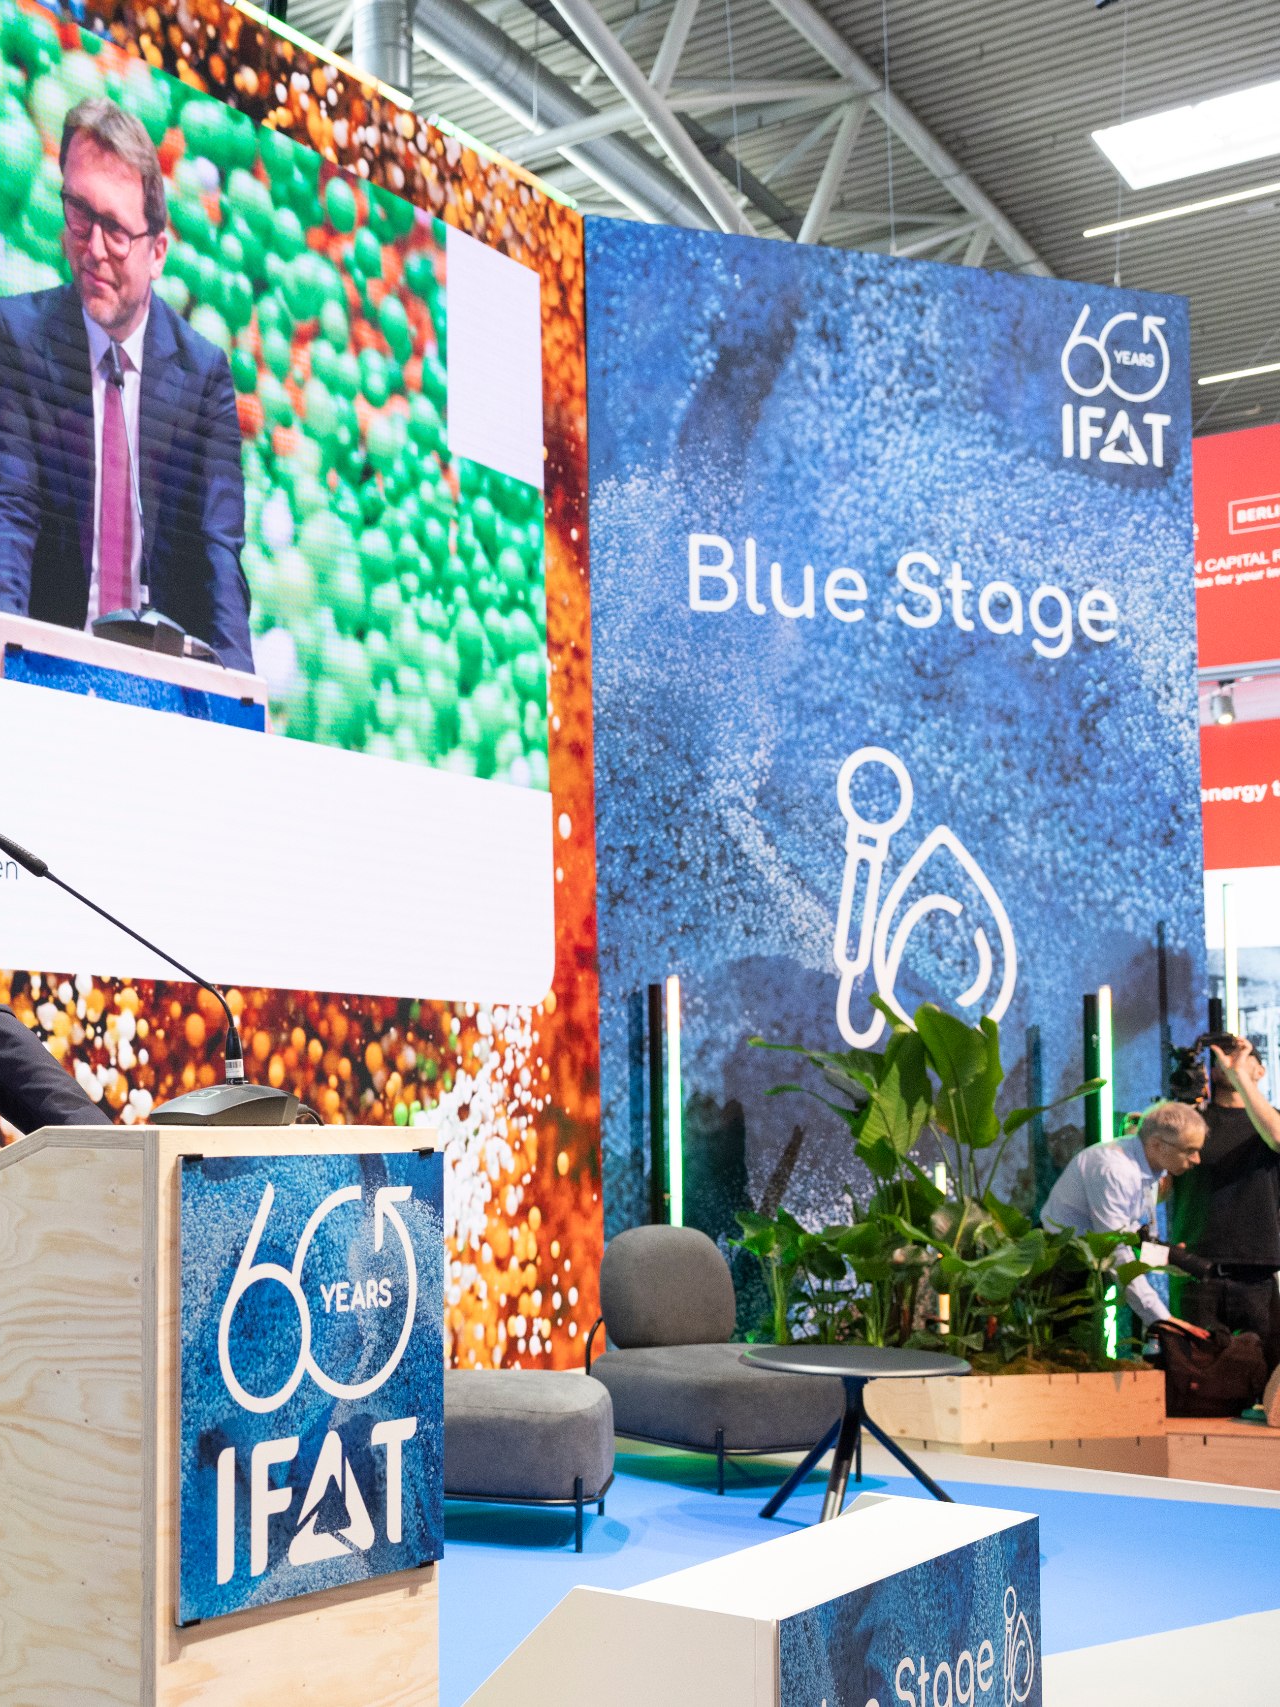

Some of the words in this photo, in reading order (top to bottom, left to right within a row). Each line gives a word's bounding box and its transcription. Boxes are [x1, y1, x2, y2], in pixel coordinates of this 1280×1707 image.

[1113, 350, 1156, 369] YEARS
[1061, 403, 1172, 468] IFAT
[1204, 551, 1270, 573] CAPITAL
[1234, 569, 1265, 586] your
[687, 532, 868, 624] Blue
[895, 551, 1120, 659] Stage
[1201, 783, 1268, 804] energy
[321, 1277, 392, 1313] YEARS
[217, 1416, 417, 1585] IFAT
[895, 1639, 994, 1707] Stage
